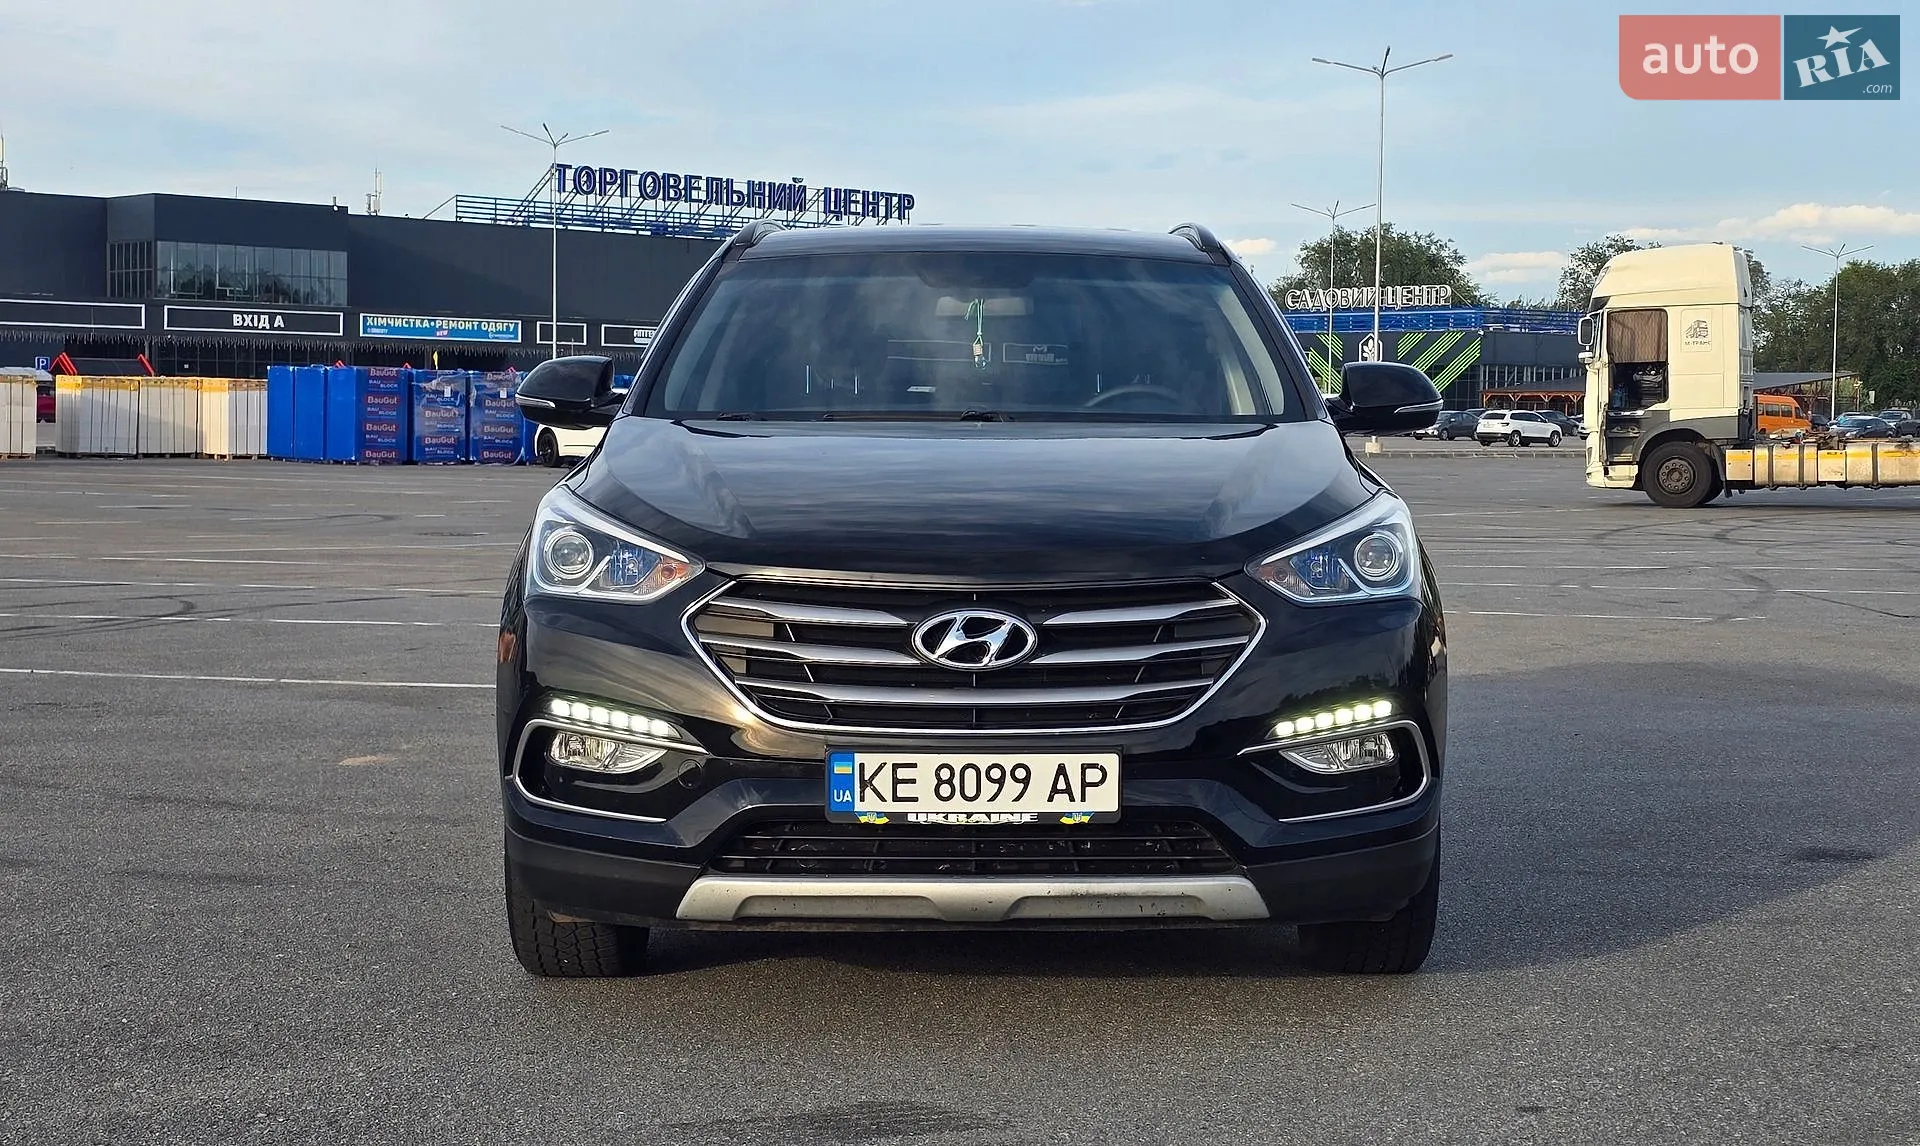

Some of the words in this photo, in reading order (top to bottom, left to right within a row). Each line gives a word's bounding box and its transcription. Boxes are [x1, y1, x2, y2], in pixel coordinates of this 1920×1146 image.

[556, 163, 807, 212] ТОРГОВЕЛЬНИЙ
[823, 186, 915, 221] ЦЕНТР
[1385, 285, 1452, 310] ЦЕНТР
[233, 313, 270, 329] ВХІД
[481, 321, 515, 333] ОДЯГУ
[39, 358, 47, 370] P
[367, 396, 397, 404] BauGut
[366, 423, 396, 432] BauGut
[425, 436, 455, 444] BauGut
[365, 450, 396, 458] BauGut
[483, 451, 512, 459] BauGut
[858, 762, 919, 803] KE
[934, 762, 1032, 803] 8099
[1046, 762, 1108, 803] AP
[833, 789, 853, 803] UA
[907, 812, 1039, 823] UKRAINE
